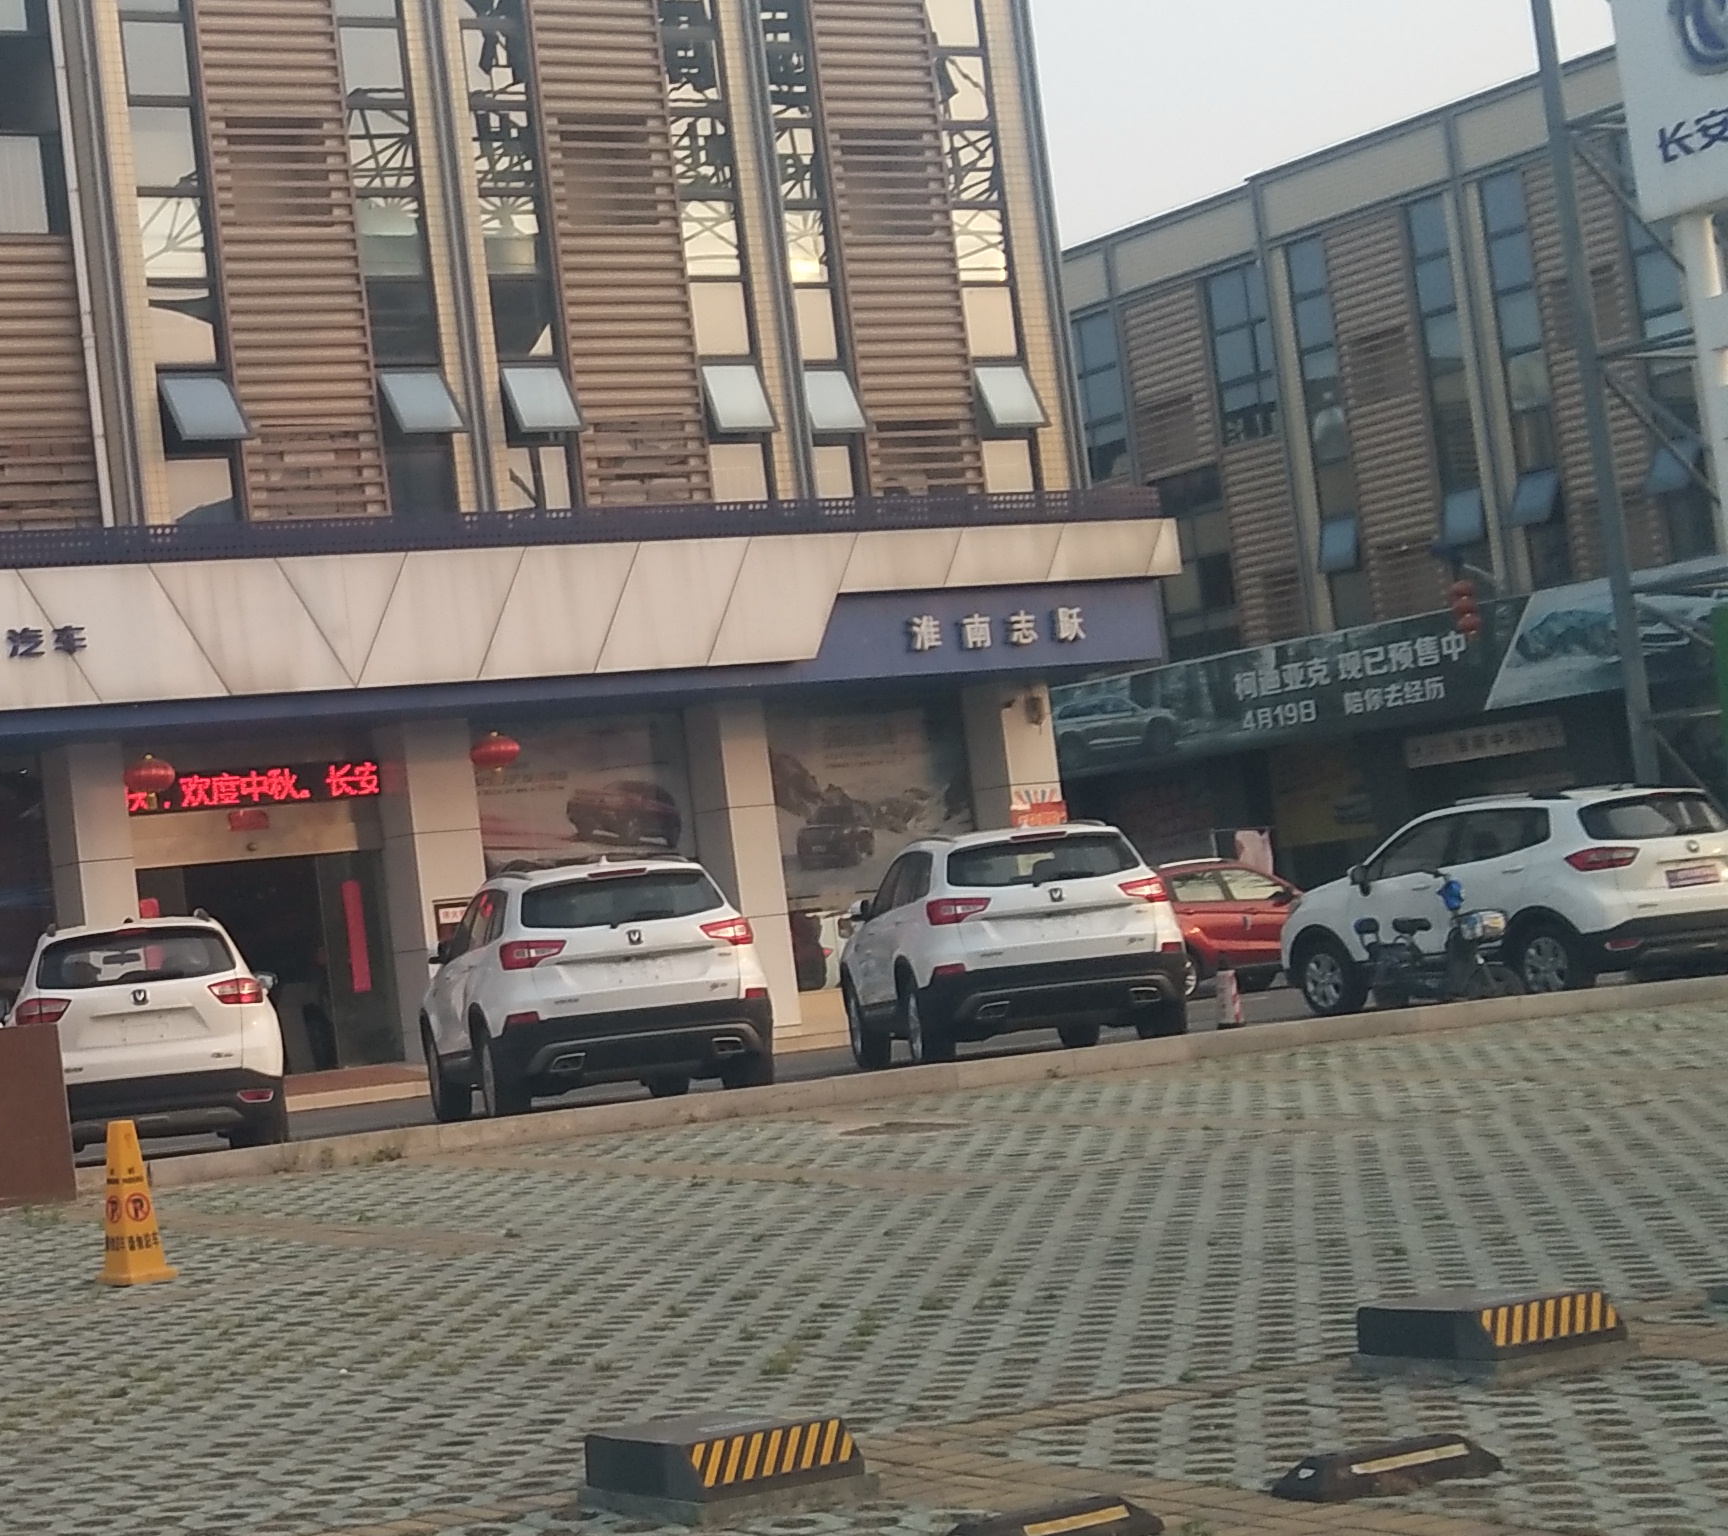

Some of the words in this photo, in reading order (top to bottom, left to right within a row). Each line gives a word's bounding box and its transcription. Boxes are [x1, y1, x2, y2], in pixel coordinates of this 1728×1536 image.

[909, 606, 1087, 652] 淮南志跃
[1337, 630, 1468, 682] 现已预售中
[1241, 699, 1318, 732] 4月19日
[1343, 675, 1446, 716] 陪你去经历
